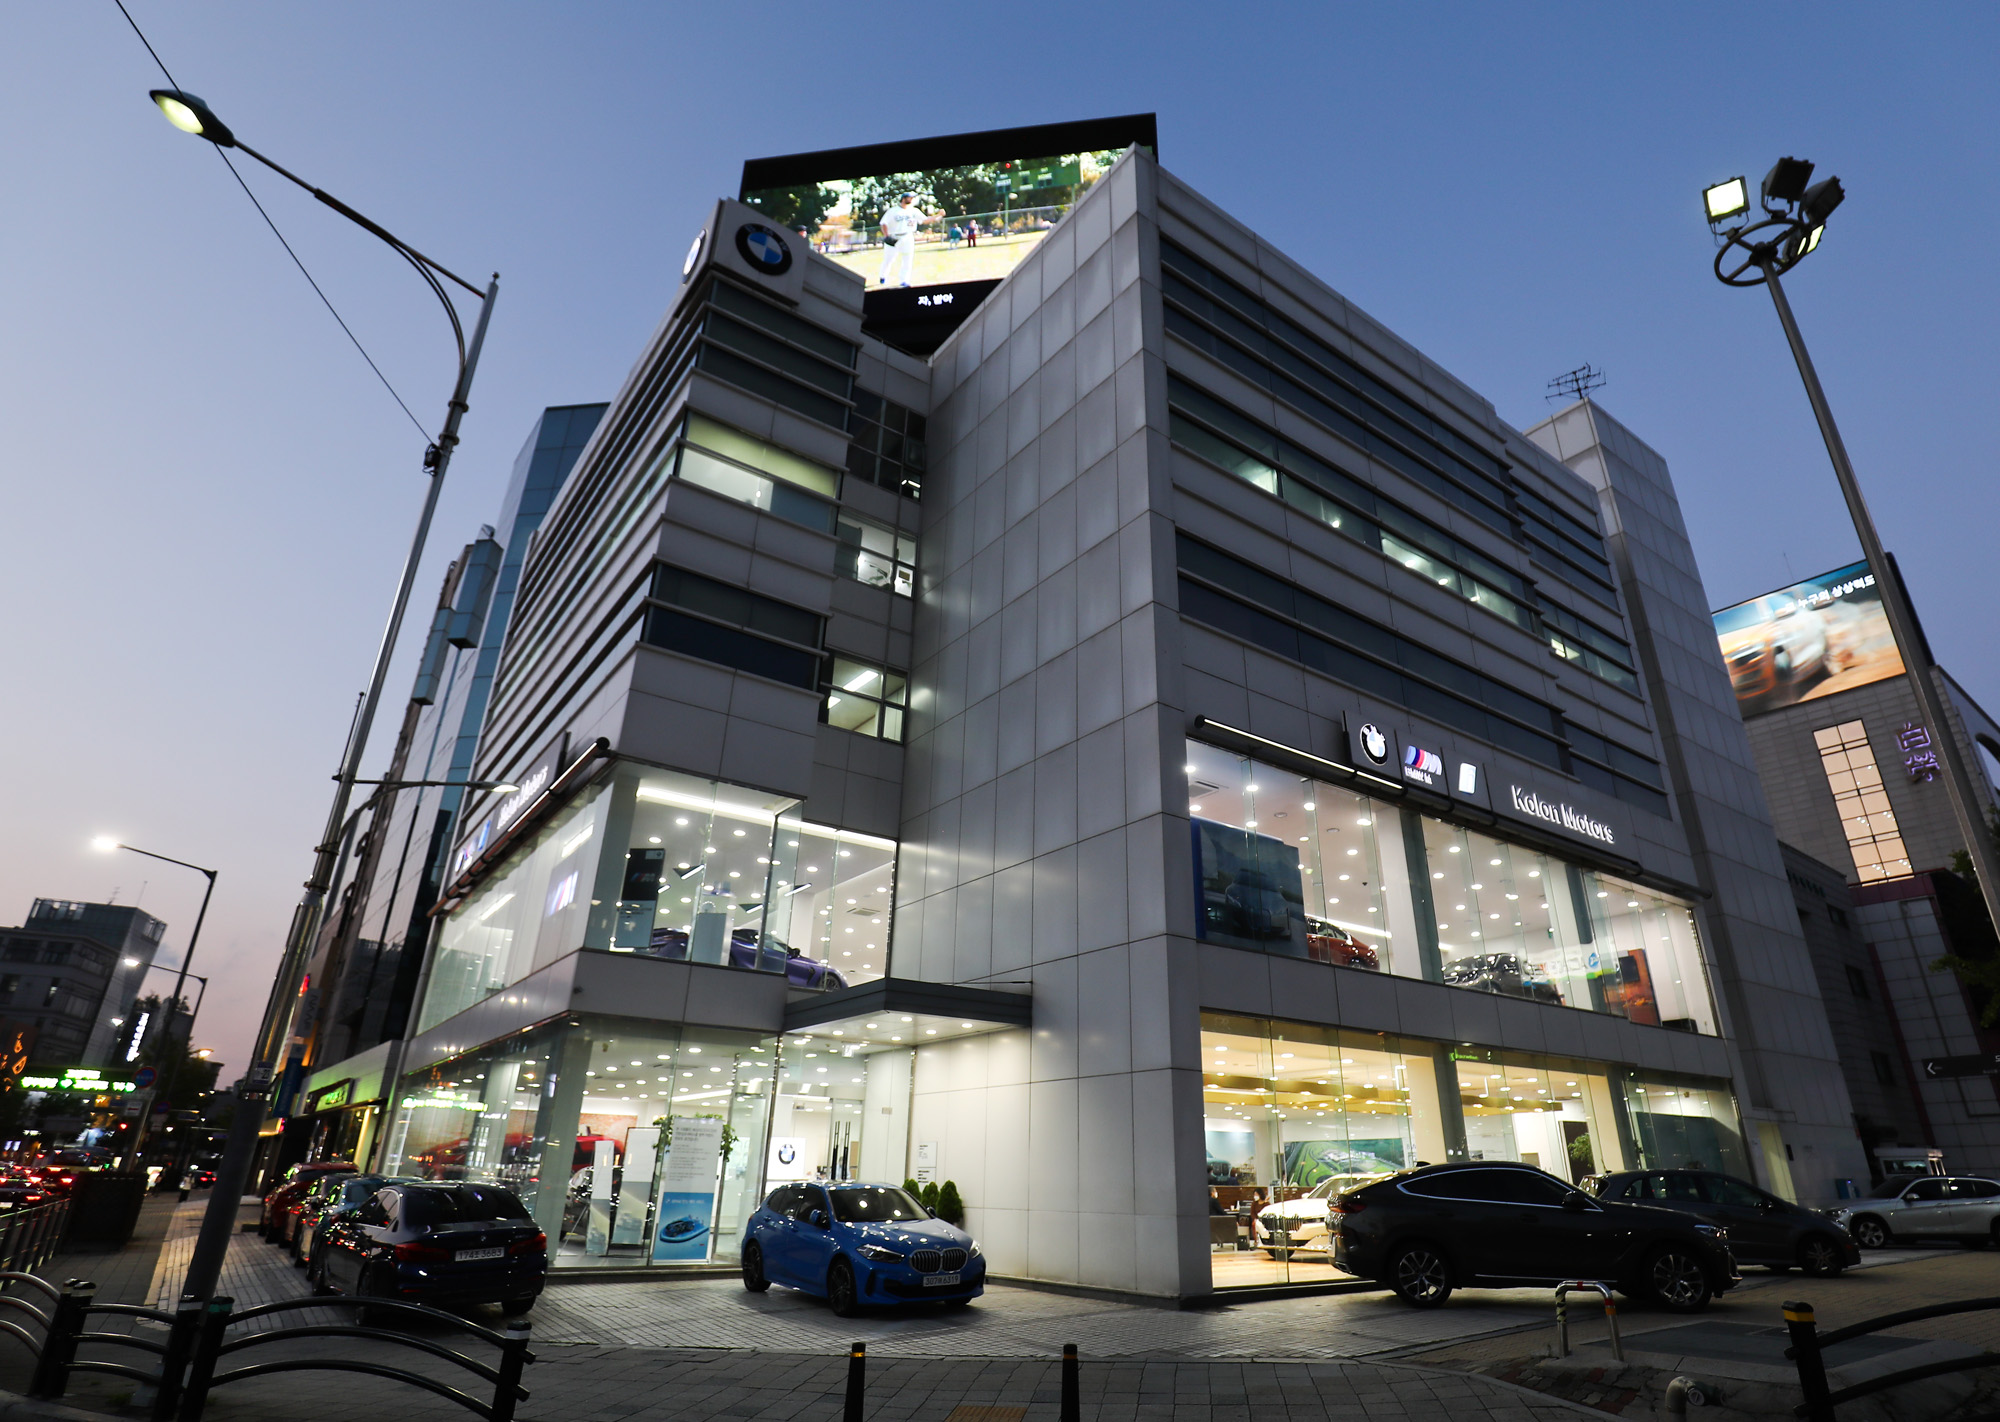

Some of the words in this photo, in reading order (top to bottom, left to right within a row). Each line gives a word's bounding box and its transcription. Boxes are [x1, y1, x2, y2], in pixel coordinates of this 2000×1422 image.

[1797, 590, 1831, 607] 누구의
[1832, 574, 1876, 598] 상상력도
[1511, 784, 1561, 825] Kolon
[1560, 803, 1615, 844] Motors
